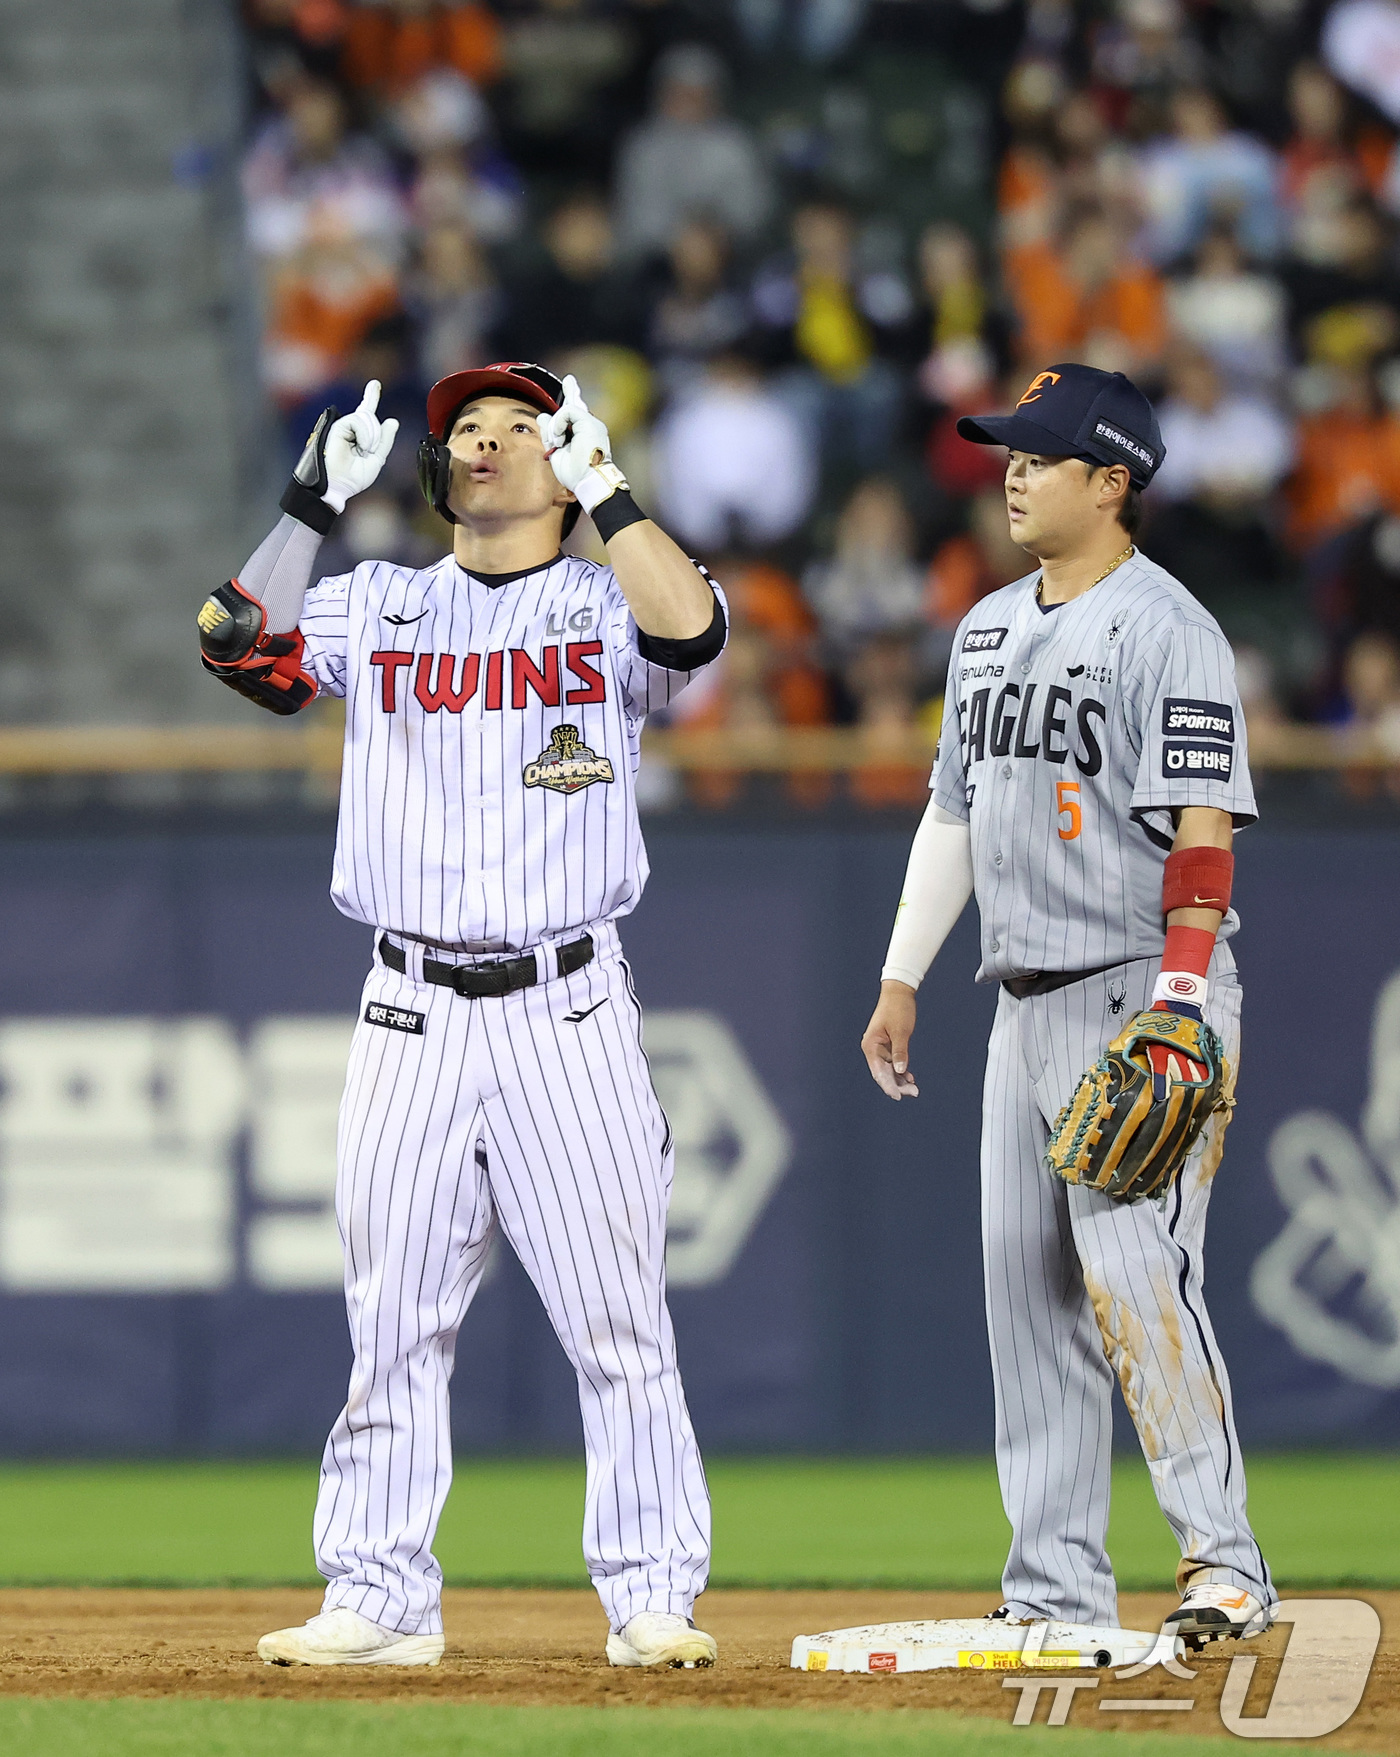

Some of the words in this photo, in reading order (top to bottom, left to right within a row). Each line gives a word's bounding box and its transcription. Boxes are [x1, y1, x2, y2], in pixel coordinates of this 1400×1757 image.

[546, 607, 594, 637] LG
[370, 640, 606, 713] TWINS
[960, 662, 1005, 681] anwha
[1086, 673, 1112, 684] PLUS
[1087, 665, 1113, 676] LIFE
[1167, 714, 1231, 733] SPORTSIX
[523, 760, 612, 784] CHAMPIONS
[1186, 750, 1230, 772] 알바몬
[1056, 782, 1083, 841] 5
[369, 1005, 388, 1022] 영진
[387, 1009, 417, 1029] 구론산
